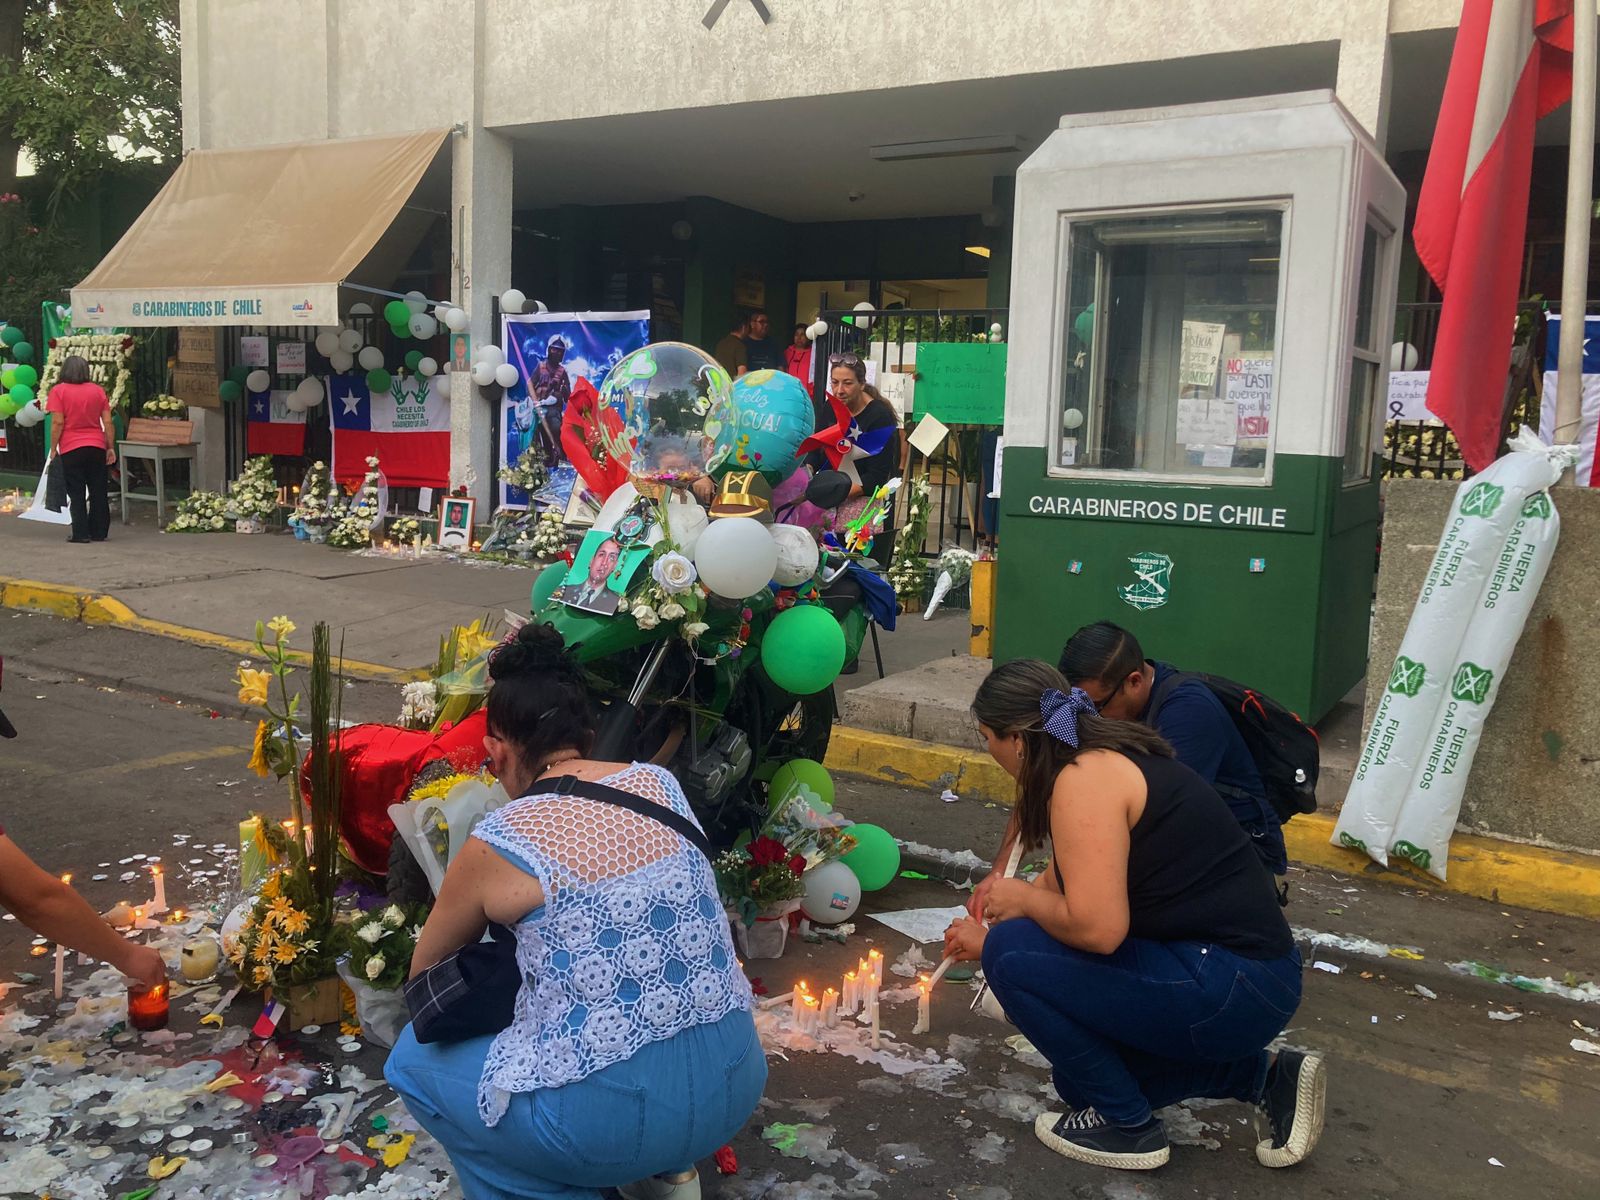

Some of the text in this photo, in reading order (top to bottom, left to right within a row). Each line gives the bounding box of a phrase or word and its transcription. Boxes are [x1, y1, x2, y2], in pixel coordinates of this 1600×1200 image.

[143, 299, 262, 317] CARABINEROS DE CHILE
[1227, 359, 1242, 373] NO
[1029, 496, 1287, 528] CARABINEROS DE CHILE
[1128, 557, 1159, 565] ARABINEROS
[1421, 517, 1464, 604] CARABINEROS
[1440, 540, 1469, 587] FUERZA
[1484, 520, 1525, 609] CARABINEROS
[1507, 543, 1536, 592] FUERZA
[1356, 694, 1392, 781] CARABINEROS
[1374, 718, 1400, 766] FUERZA
[1419, 702, 1458, 790] CARABINEROS
[1441, 727, 1467, 775] FUERZA
